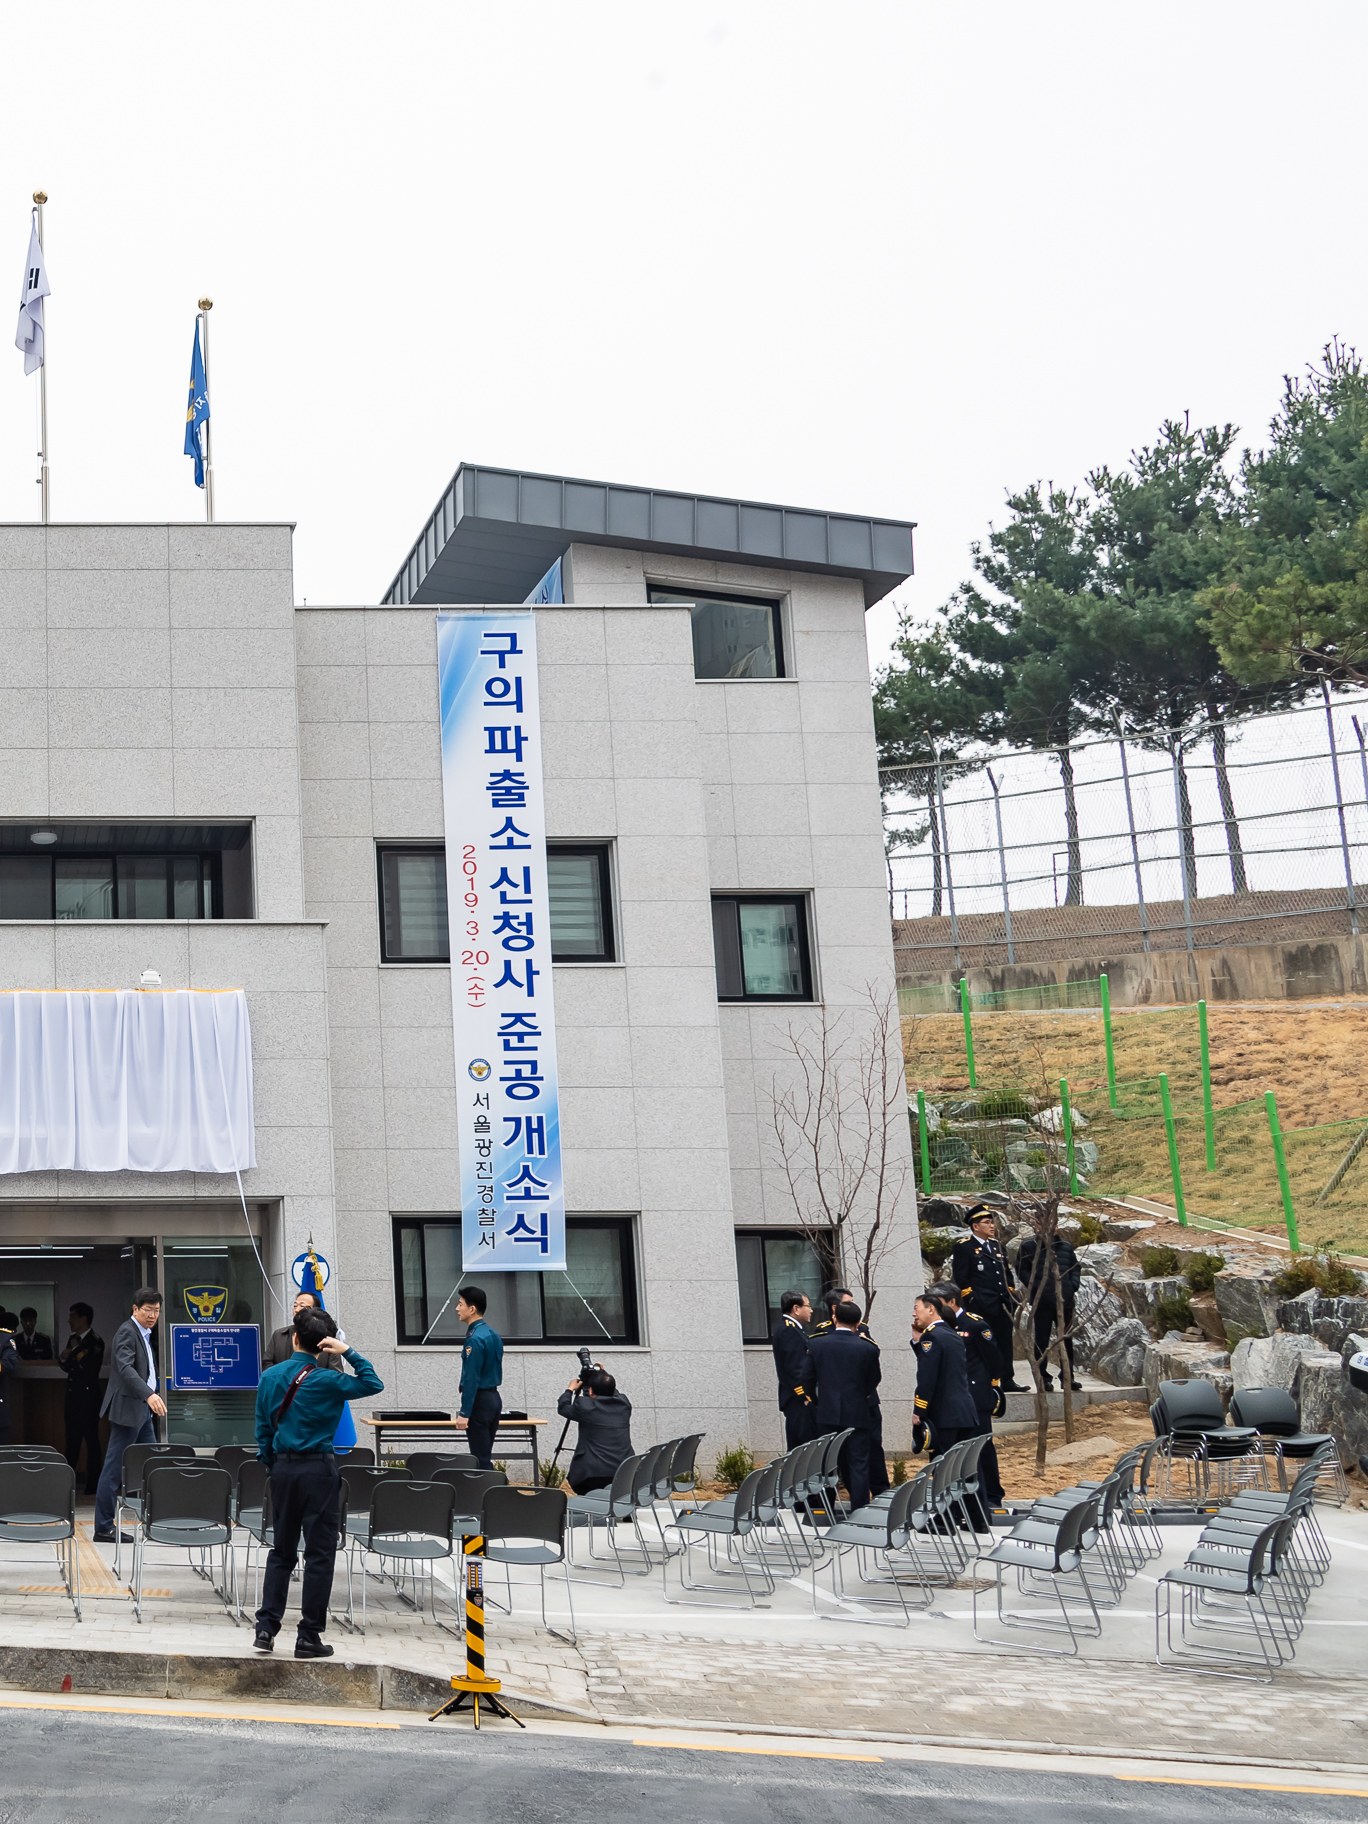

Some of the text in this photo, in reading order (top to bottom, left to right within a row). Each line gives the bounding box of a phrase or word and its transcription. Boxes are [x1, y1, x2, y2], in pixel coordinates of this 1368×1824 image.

[490, 864, 542, 999] 신청사
[472, 1092, 497, 1251] 서울광진경찰서
[502, 1114, 551, 1255] 개소식
